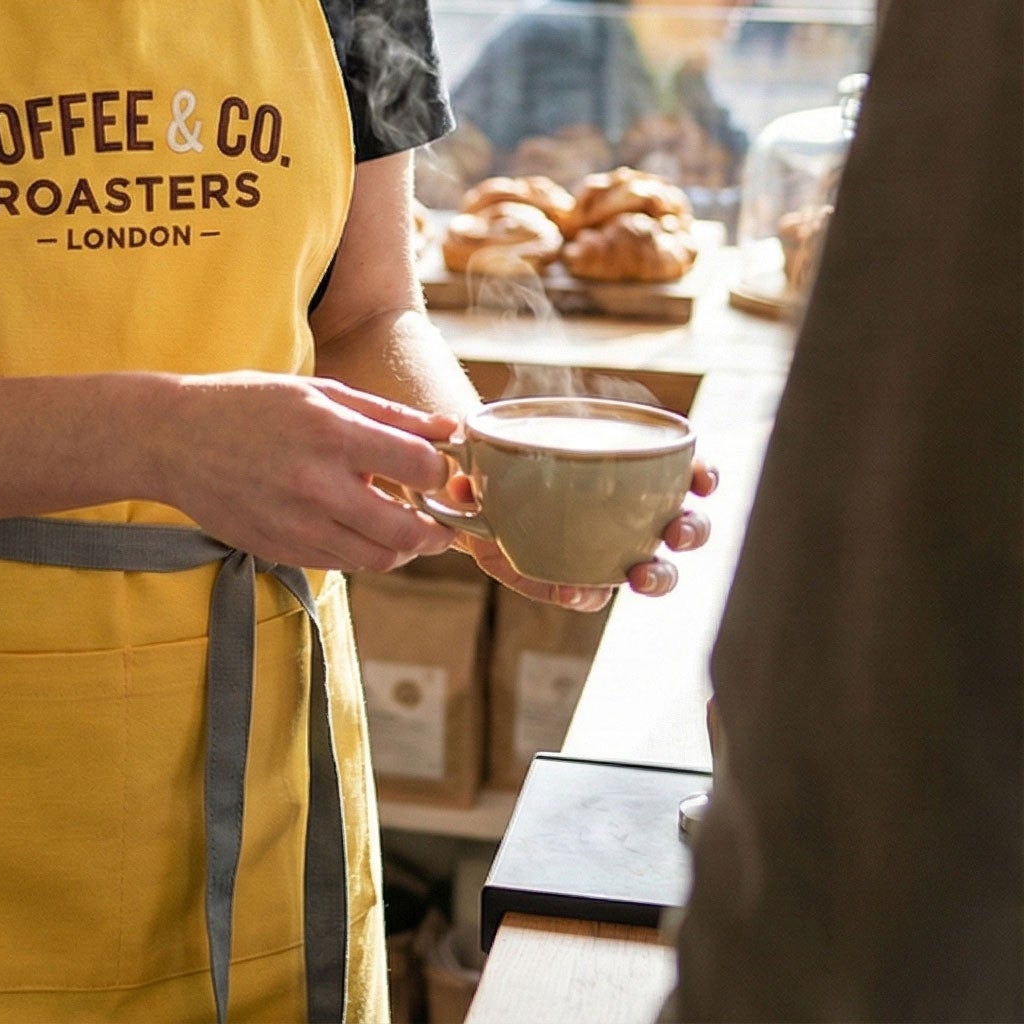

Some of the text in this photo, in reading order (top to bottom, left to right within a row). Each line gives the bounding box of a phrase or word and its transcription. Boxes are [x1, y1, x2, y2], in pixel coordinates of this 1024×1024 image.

[166, 89, 203, 153] &
[216, 96, 291, 168] CO.
[67, 225, 191, 250] LONDON
